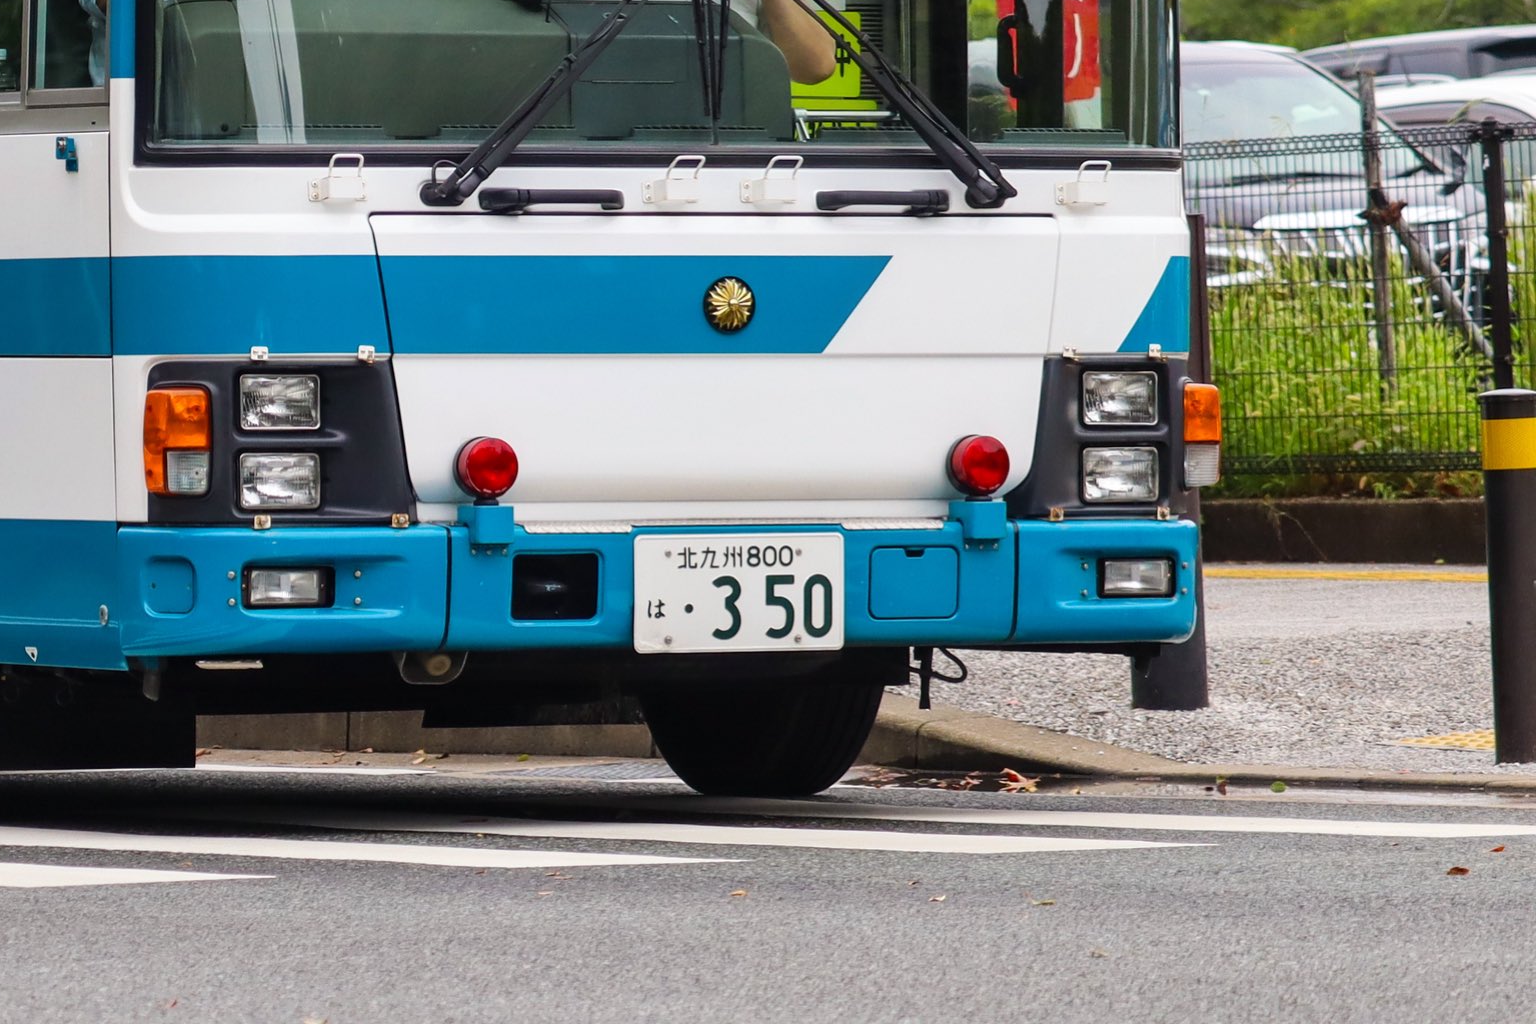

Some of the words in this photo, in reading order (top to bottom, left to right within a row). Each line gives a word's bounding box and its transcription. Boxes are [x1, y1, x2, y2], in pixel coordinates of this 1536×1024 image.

[677, 544, 794, 570] 北九州800
[647, 598, 666, 620] は
